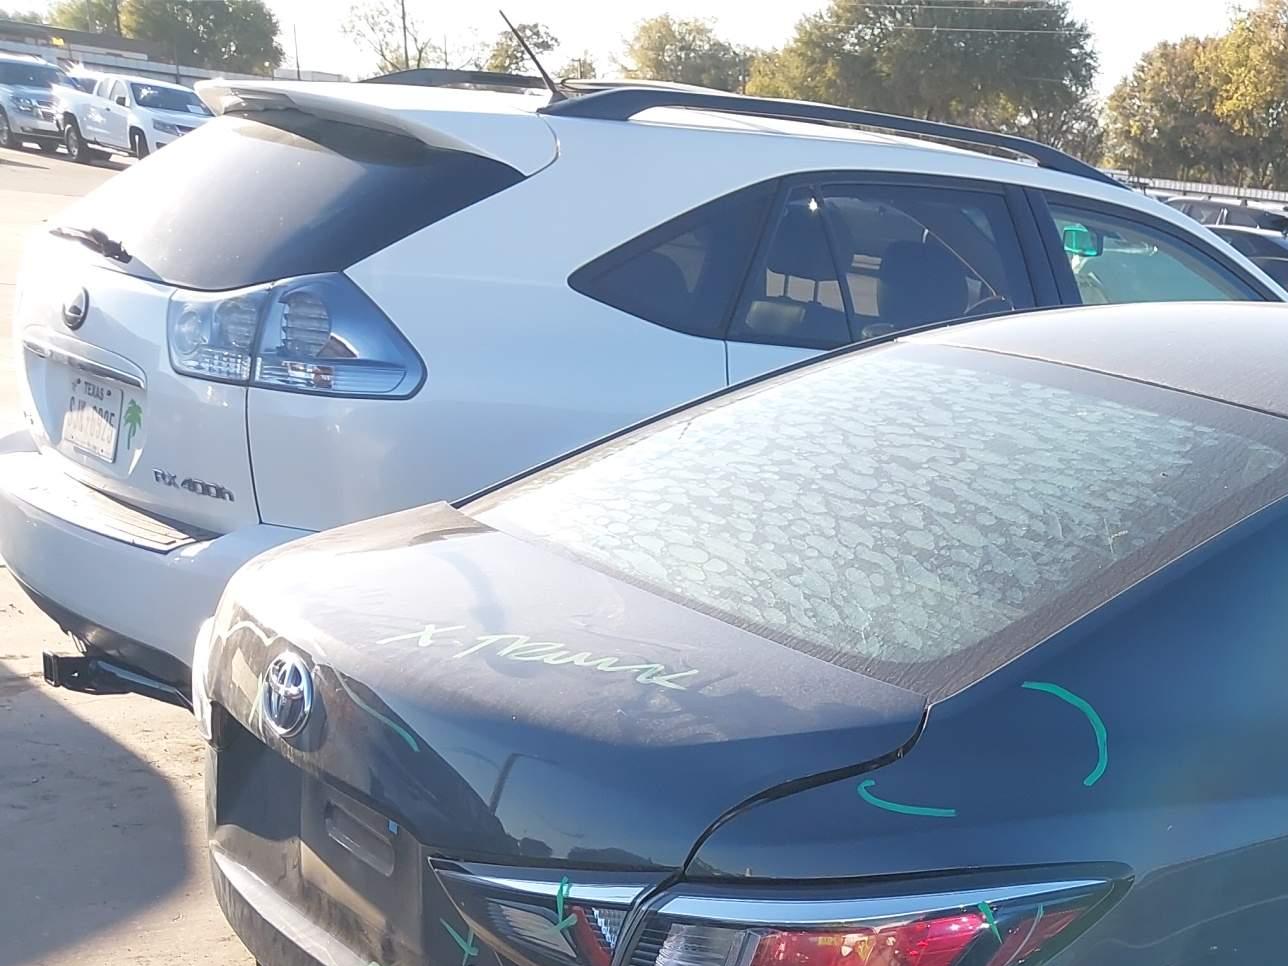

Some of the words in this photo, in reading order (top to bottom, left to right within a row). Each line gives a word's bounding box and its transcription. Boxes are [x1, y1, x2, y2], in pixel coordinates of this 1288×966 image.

[84, 381, 105, 401] TEXAS
[152, 468, 179, 489] RX
[181, 479, 235, 502] 400h
